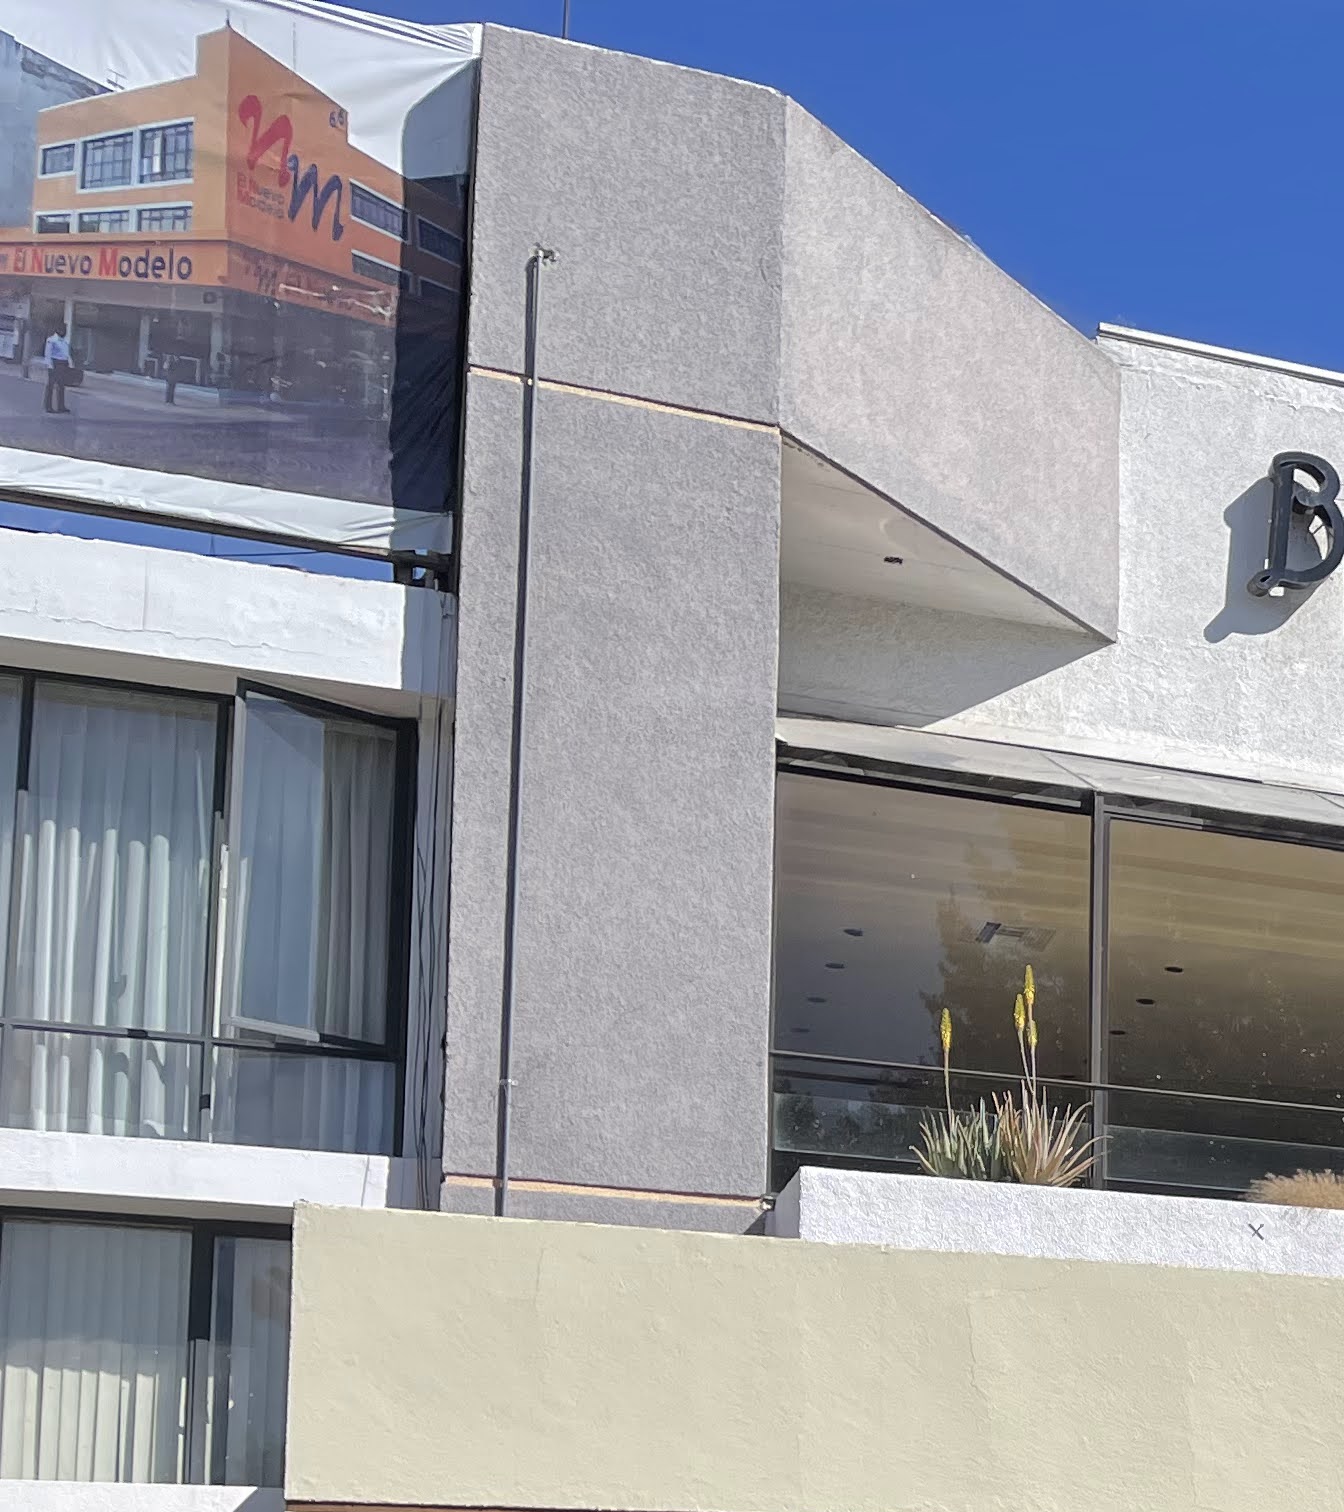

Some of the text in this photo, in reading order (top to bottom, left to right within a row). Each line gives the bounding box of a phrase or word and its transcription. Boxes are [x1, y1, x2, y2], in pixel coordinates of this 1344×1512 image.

[13, 247, 26, 273] El
[31, 248, 92, 275] Nuevo
[98, 247, 193, 281] Modelo
